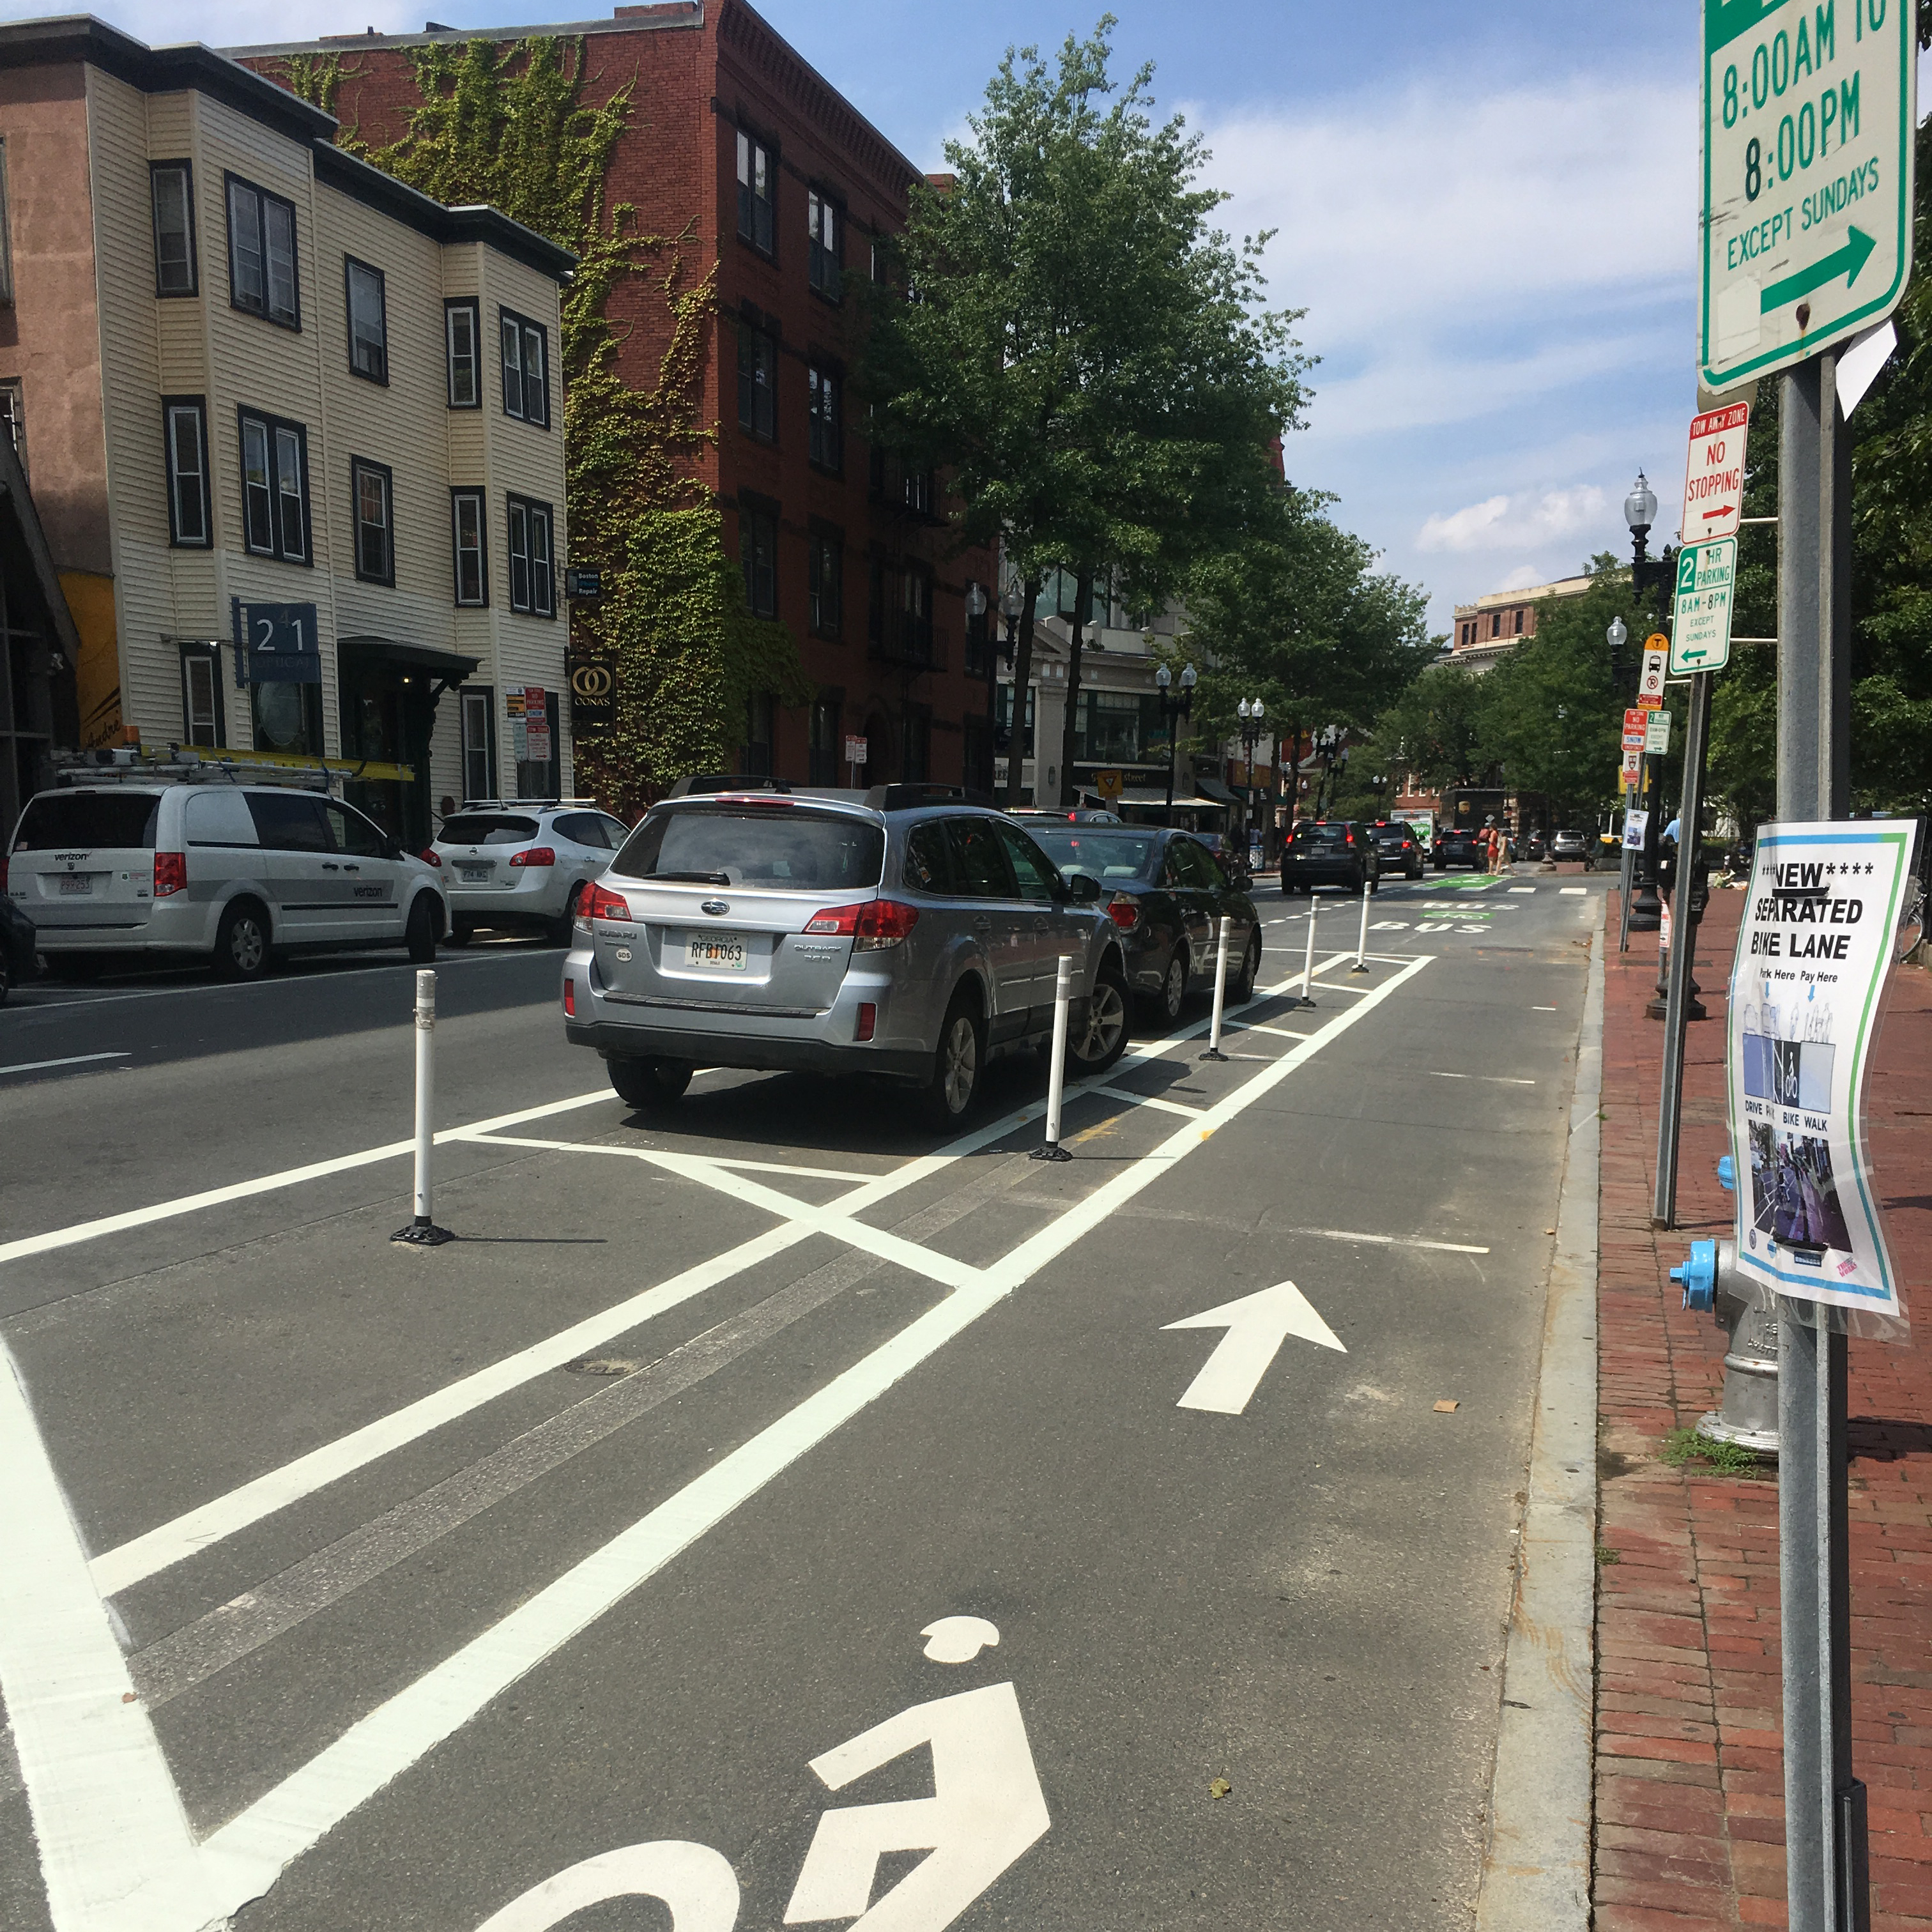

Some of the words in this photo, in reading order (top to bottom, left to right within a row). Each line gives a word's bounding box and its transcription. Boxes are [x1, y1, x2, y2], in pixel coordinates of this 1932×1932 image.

[1723, 0, 1835, 129] 8:00AM
[1745, 70, 1860, 203] 8:00PM
[1728, 207, 1793, 271] EXCEPT
[1802, 157, 1880, 231] SUNDAYS
[1692, 419, 1706, 436] TOW
[1708, 413, 1726, 432] AWAY
[1727, 407, 1745, 426] ZONE
[1706, 441, 1725, 466] NO
[1688, 468, 1739, 502] STOPPING
[1680, 557, 1694, 588] 2
[1708, 548, 1722, 565] HR
[1696, 565, 1730, 586] PARKING
[1690, 615, 1714, 627] EXCEPT
[1686, 630, 1716, 642] SUNDAYS
[574, 696, 610, 706] OONA'S
[1649, 714, 1654, 723] 2
[1625, 723, 1645, 732] PARKING
[54, 852, 87, 861] verizon
[354, 885, 383, 897] verizon
[1422, 902, 1519, 910] BUS
[1755, 898, 1863, 924] SEPARATED
[598, 928, 638, 940] SUBARU
[1367, 921, 1492, 933] BUS
[1751, 931, 1781, 956] BIKE
[1790, 933, 1851, 960] LANE
[1774, 969, 1795, 980] Here
[1800, 970, 1815, 984] Pay
[1816, 971, 1838, 983] Here
[1745, 1100, 1763, 1115] DRIVE
[1782, 1112, 1800, 1126] BIKE
[1804, 1116, 1828, 1132] WALK
